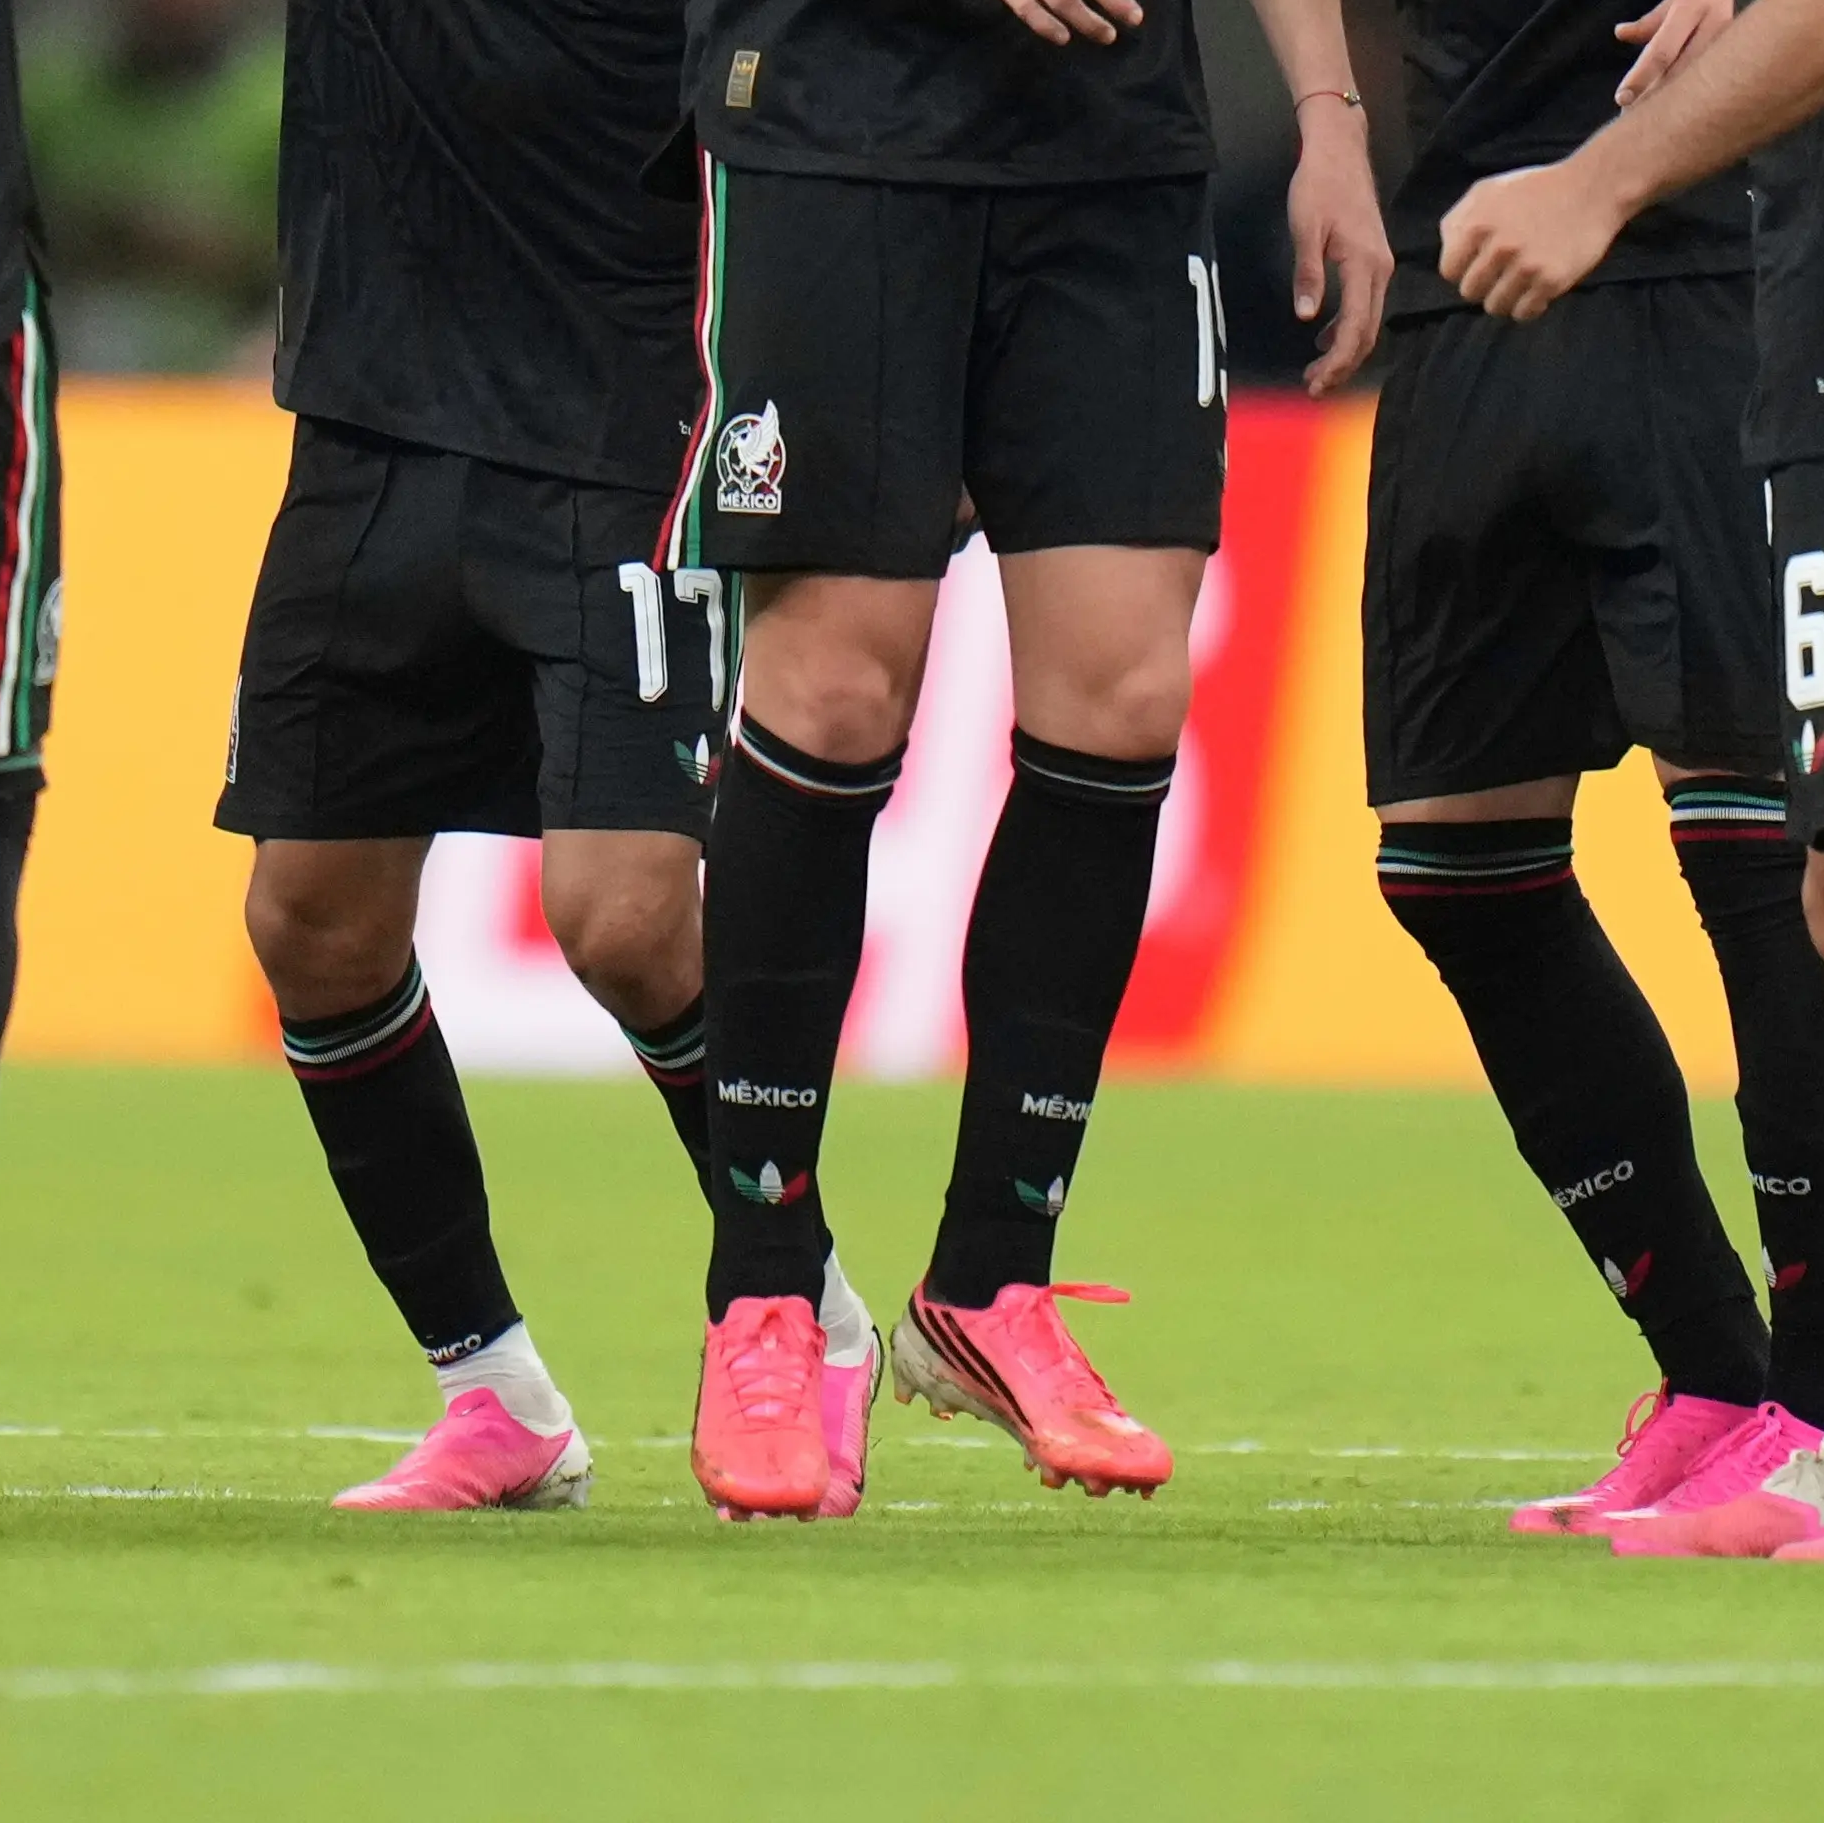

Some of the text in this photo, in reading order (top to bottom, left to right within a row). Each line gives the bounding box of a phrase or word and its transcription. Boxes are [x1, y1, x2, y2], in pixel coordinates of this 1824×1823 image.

[1187, 254, 1227, 411] 1
[720, 489, 777, 509] MÉXICO
[618, 561, 725, 712] 17
[717, 1078, 817, 1108] MÉXICO
[1553, 1160, 1634, 1208] ÉXICO
